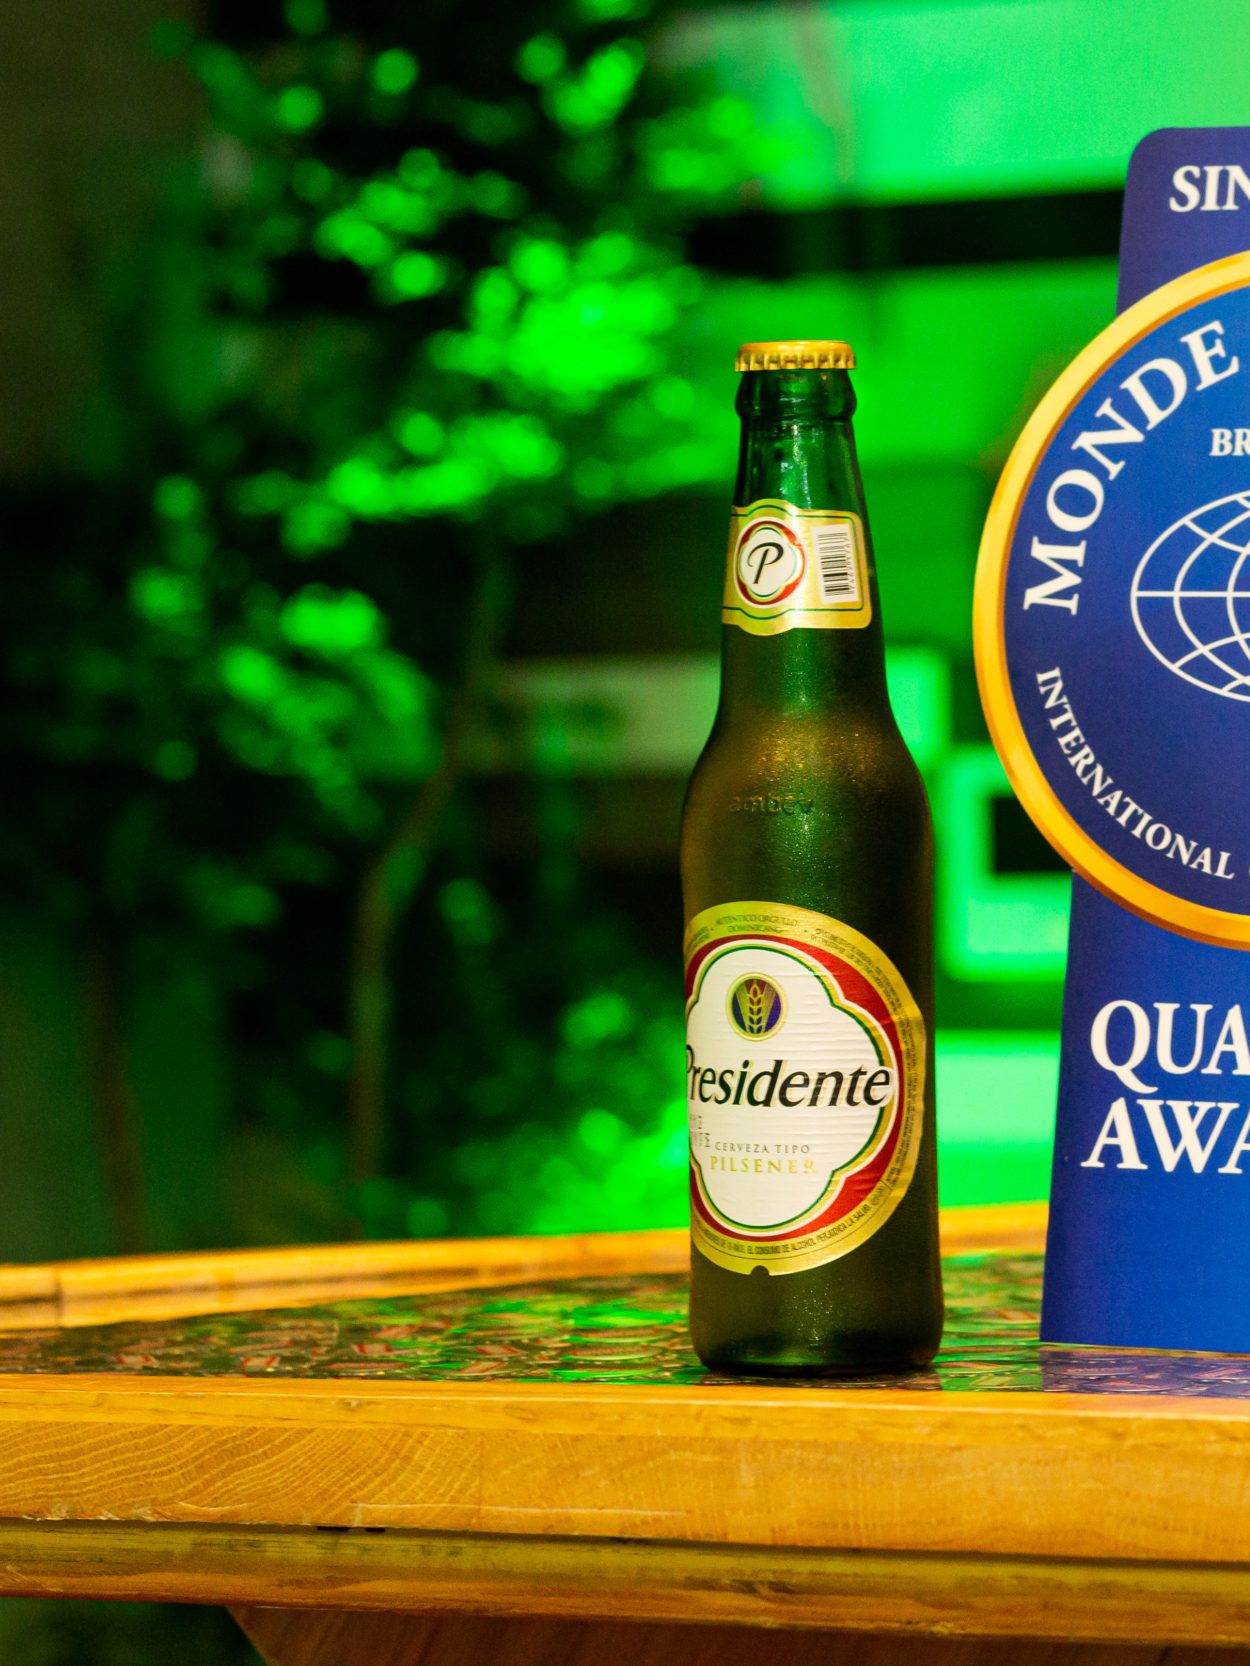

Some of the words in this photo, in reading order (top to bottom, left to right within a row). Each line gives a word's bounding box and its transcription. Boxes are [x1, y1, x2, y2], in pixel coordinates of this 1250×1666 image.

[1022, 320, 1240, 616] MONDE
[746, 542, 784, 584] P
[1035, 666, 1235, 880] INTERNATIONAL
[710, 1155, 815, 1174] PILSENER
[715, 1142, 769, 1154] CERVEZA
[775, 1144, 811, 1154] TIPO
